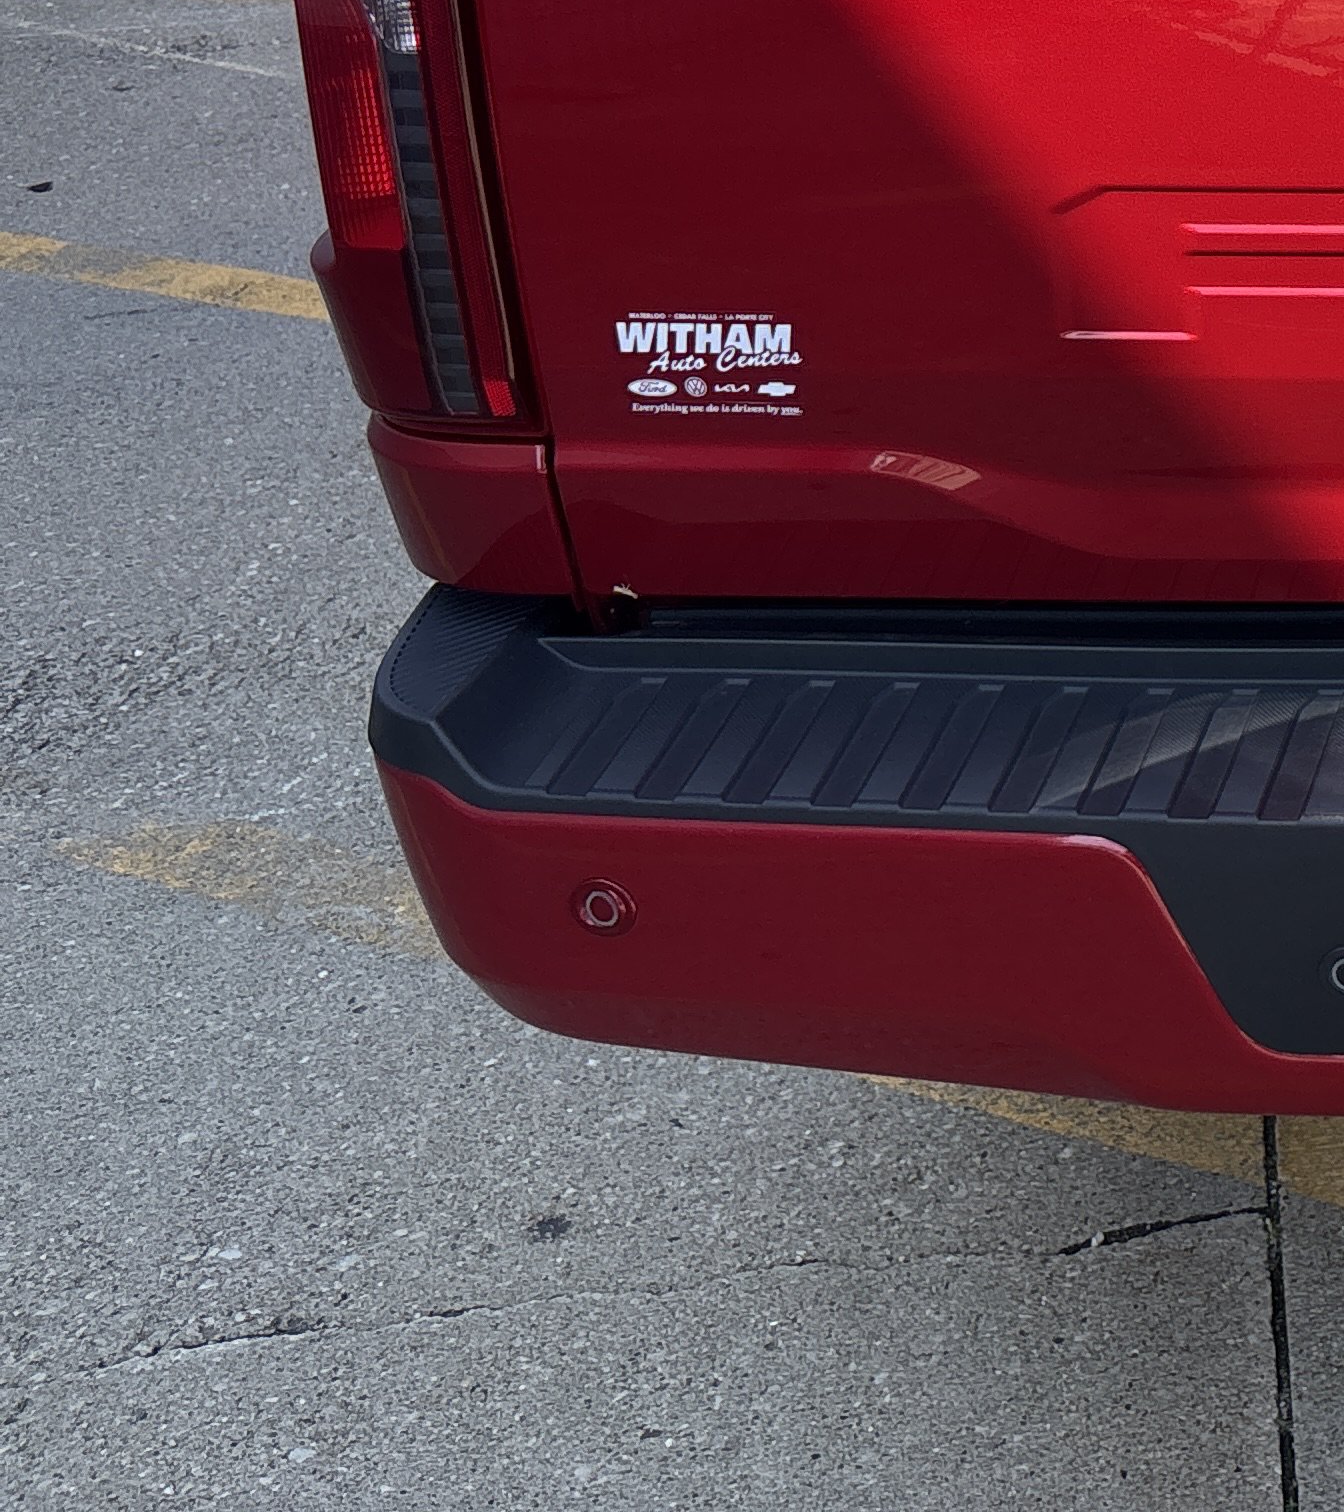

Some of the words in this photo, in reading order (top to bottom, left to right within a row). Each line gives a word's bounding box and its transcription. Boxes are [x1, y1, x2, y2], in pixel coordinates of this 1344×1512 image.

[616, 322, 792, 354] WITHAM
[647, 350, 708, 374] Auto
[715, 346, 804, 373] Centers
[632, 402, 689, 415] Everything
[689, 405, 705, 413] we
[705, 403, 720, 413] do
[721, 403, 730, 413] is
[731, 403, 765, 413] driven
[766, 404, 780, 416] by
